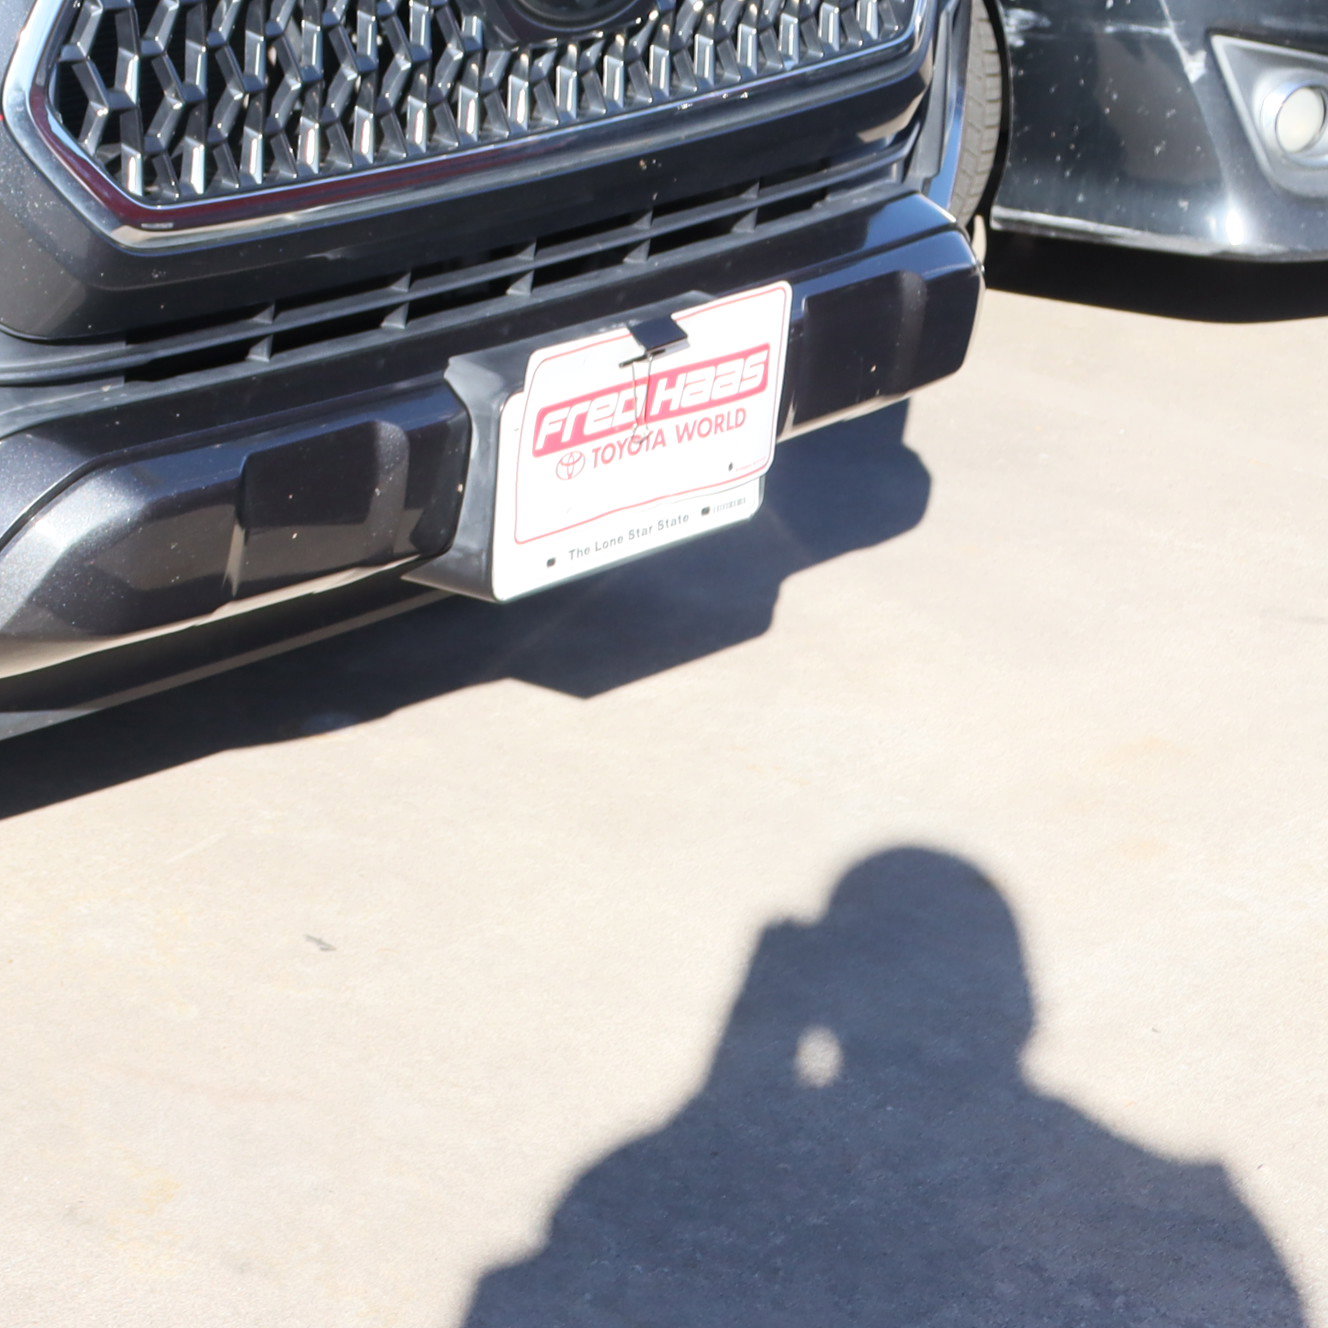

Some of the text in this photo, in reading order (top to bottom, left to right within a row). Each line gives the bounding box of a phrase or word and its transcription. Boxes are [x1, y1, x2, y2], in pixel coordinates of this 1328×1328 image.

[592, 407, 747, 469] TOYOTA WORLD
[568, 513, 690, 561] The Lone Star State
